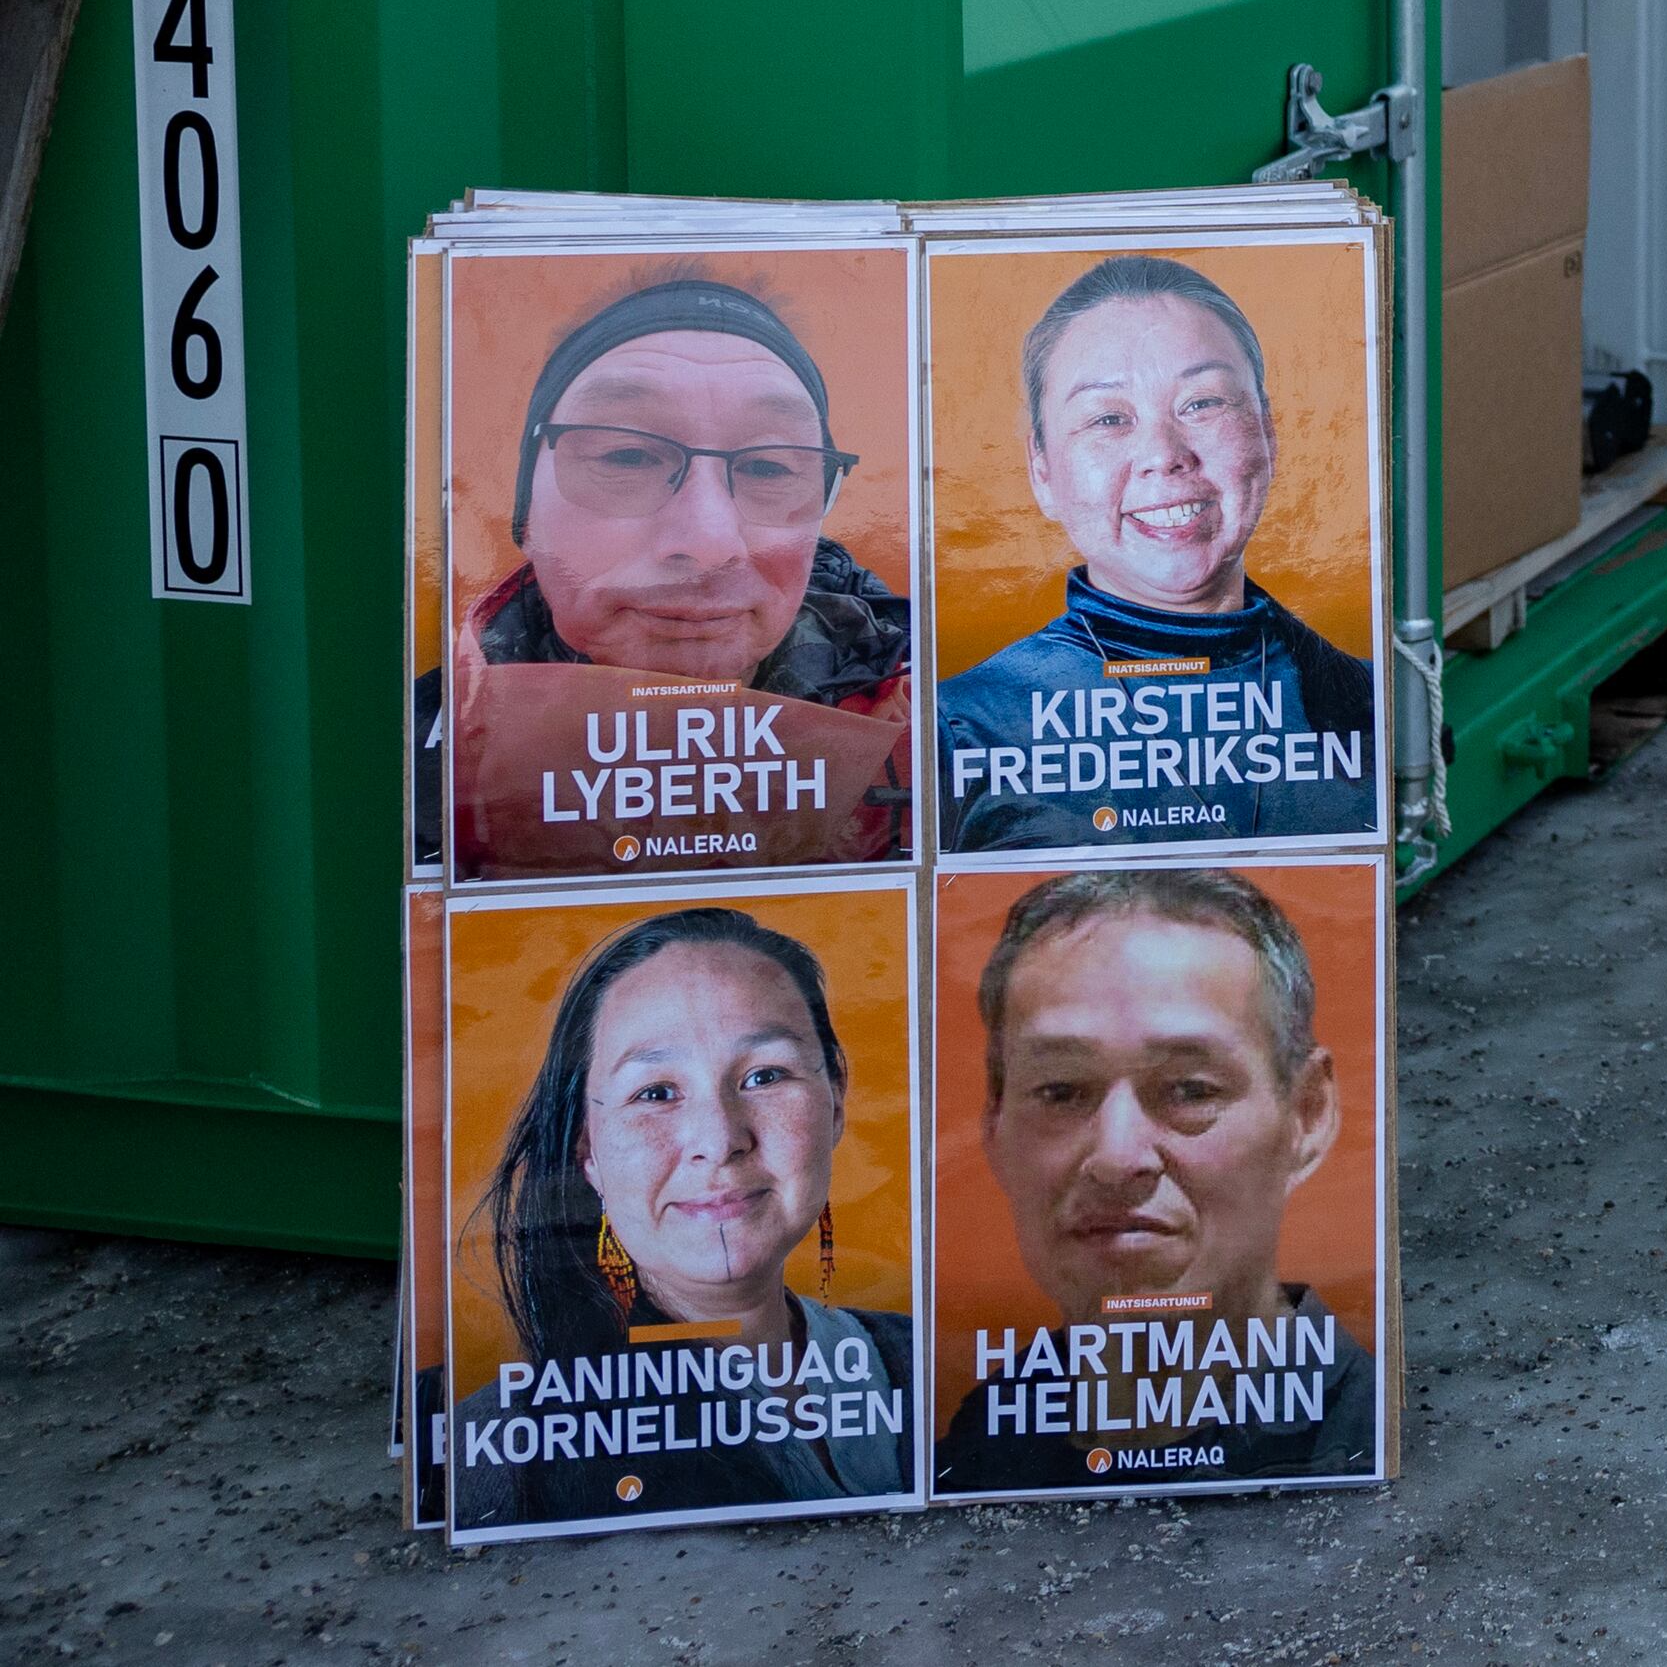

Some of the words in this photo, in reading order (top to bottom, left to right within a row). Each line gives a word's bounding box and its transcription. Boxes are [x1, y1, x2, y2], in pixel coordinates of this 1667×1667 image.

[632, 683, 737, 697] INATSISARTUNUT
[1108, 661, 1206, 674] INATSISARTUNUT
[588, 705, 785, 763] ULRIK
[1033, 681, 1282, 739] KIRSTEN
[544, 759, 825, 821] LYBERTH
[954, 731, 1362, 797] FREDERIKSEN
[646, 834, 758, 857] NALERAQ
[1122, 805, 1226, 828] NALERAQ
[1107, 1296, 1208, 1309] INATSISARTUNUT
[499, 1337, 872, 1408] PANINNGUAQ
[976, 1315, 1335, 1380] HARTMANN
[465, 1388, 902, 1466] KORNELIUSSEN
[989, 1372, 1322, 1434] HEILMANN
[1119, 1447, 1225, 1469] NALERAQ
